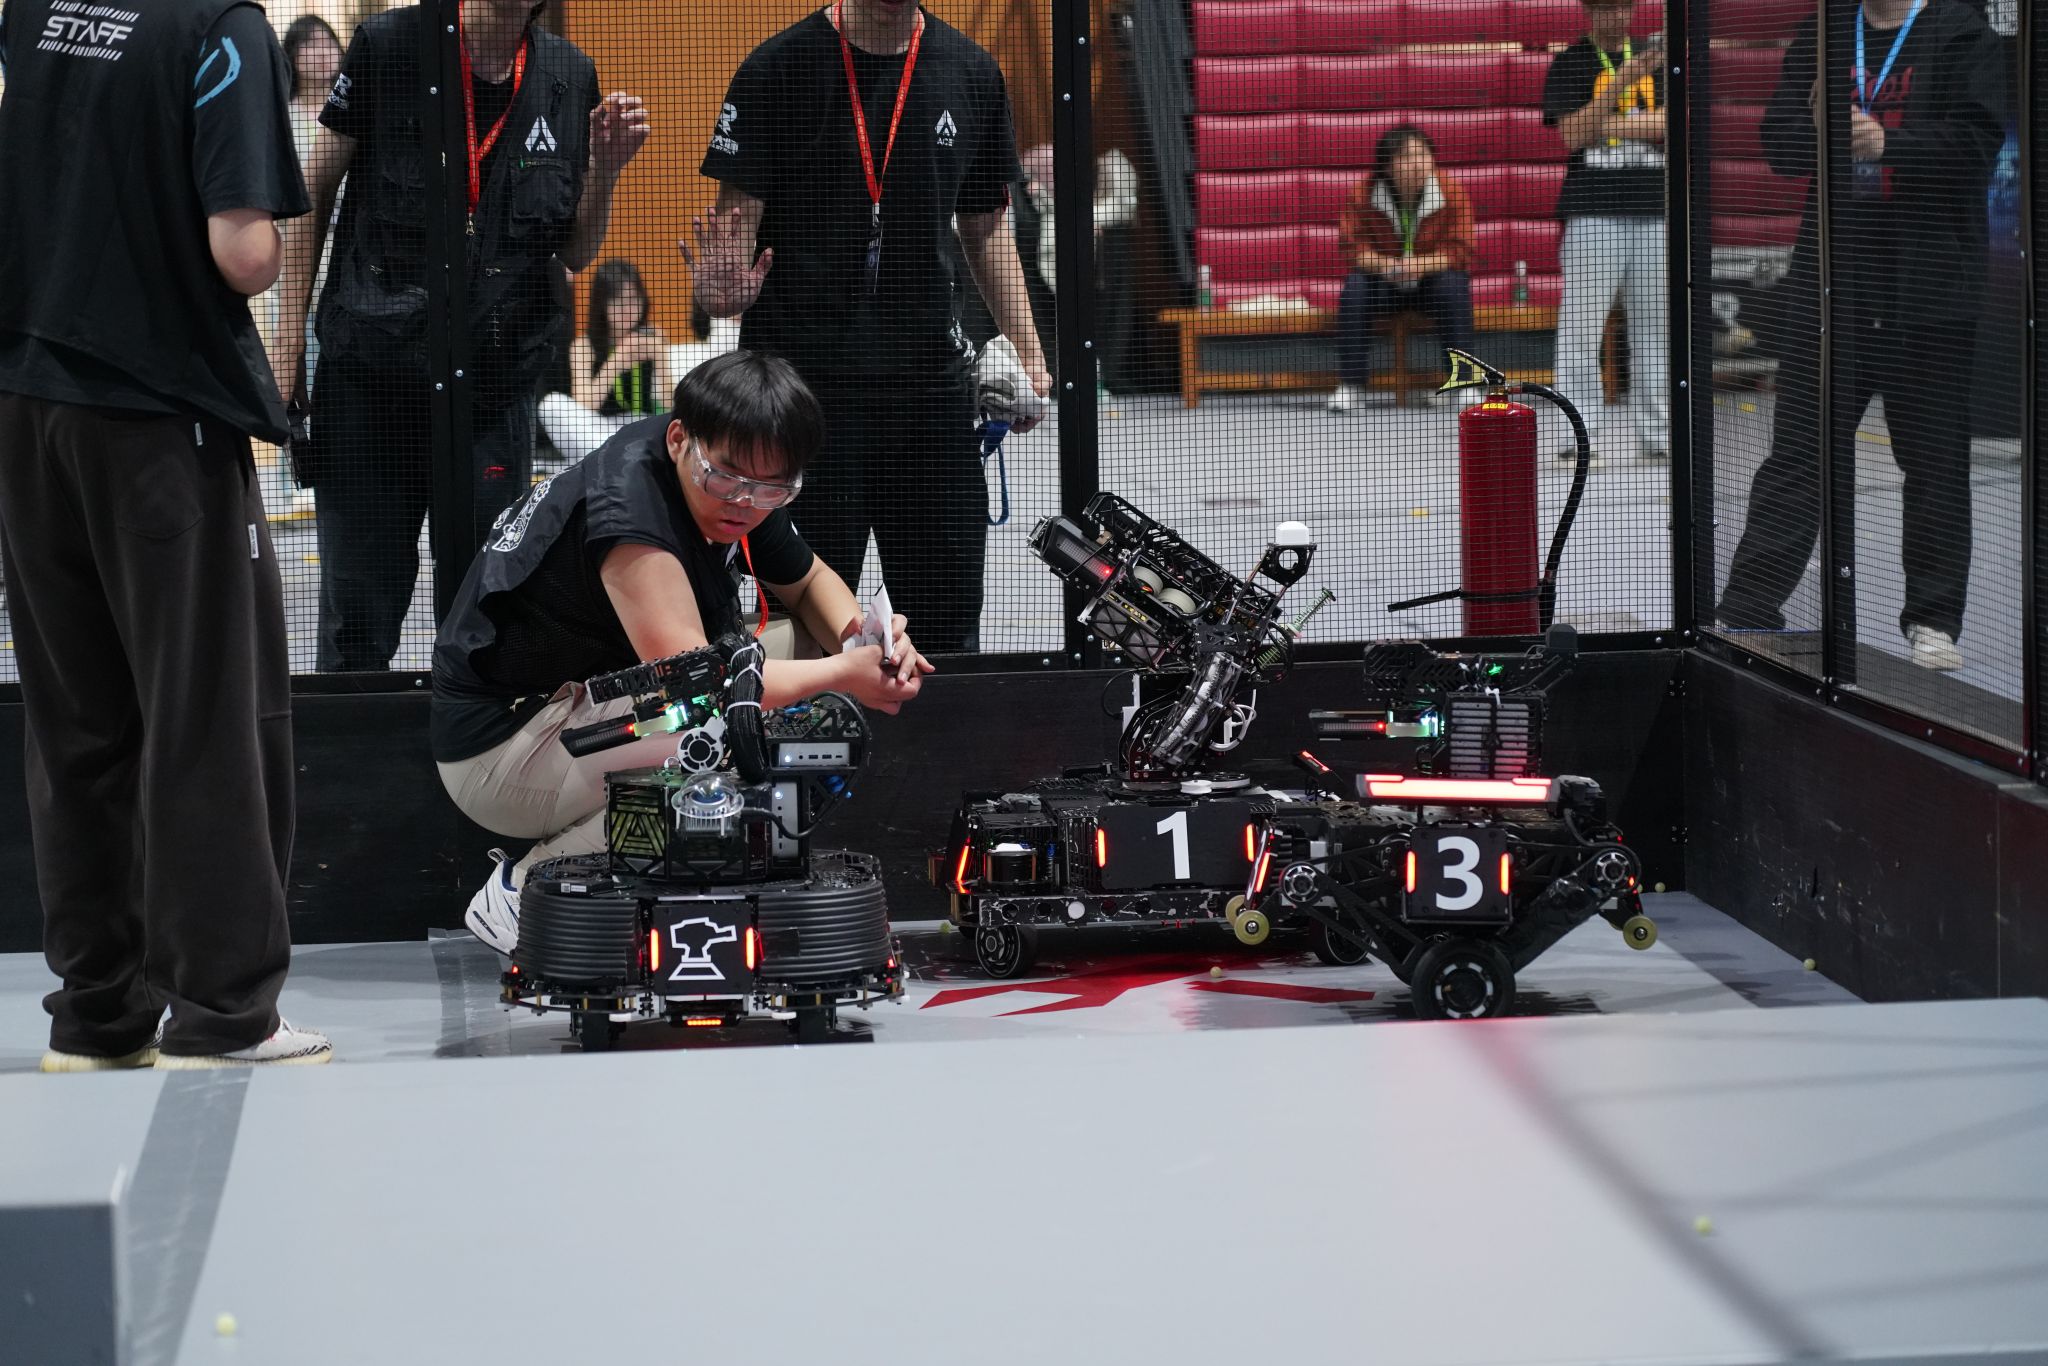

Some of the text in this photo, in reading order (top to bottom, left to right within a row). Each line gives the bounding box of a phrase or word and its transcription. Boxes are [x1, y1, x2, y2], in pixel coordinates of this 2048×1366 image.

[42, 15, 133, 45] STAFF
[1156, 811, 1190, 880] 1
[1436, 836, 1484, 911] 3
